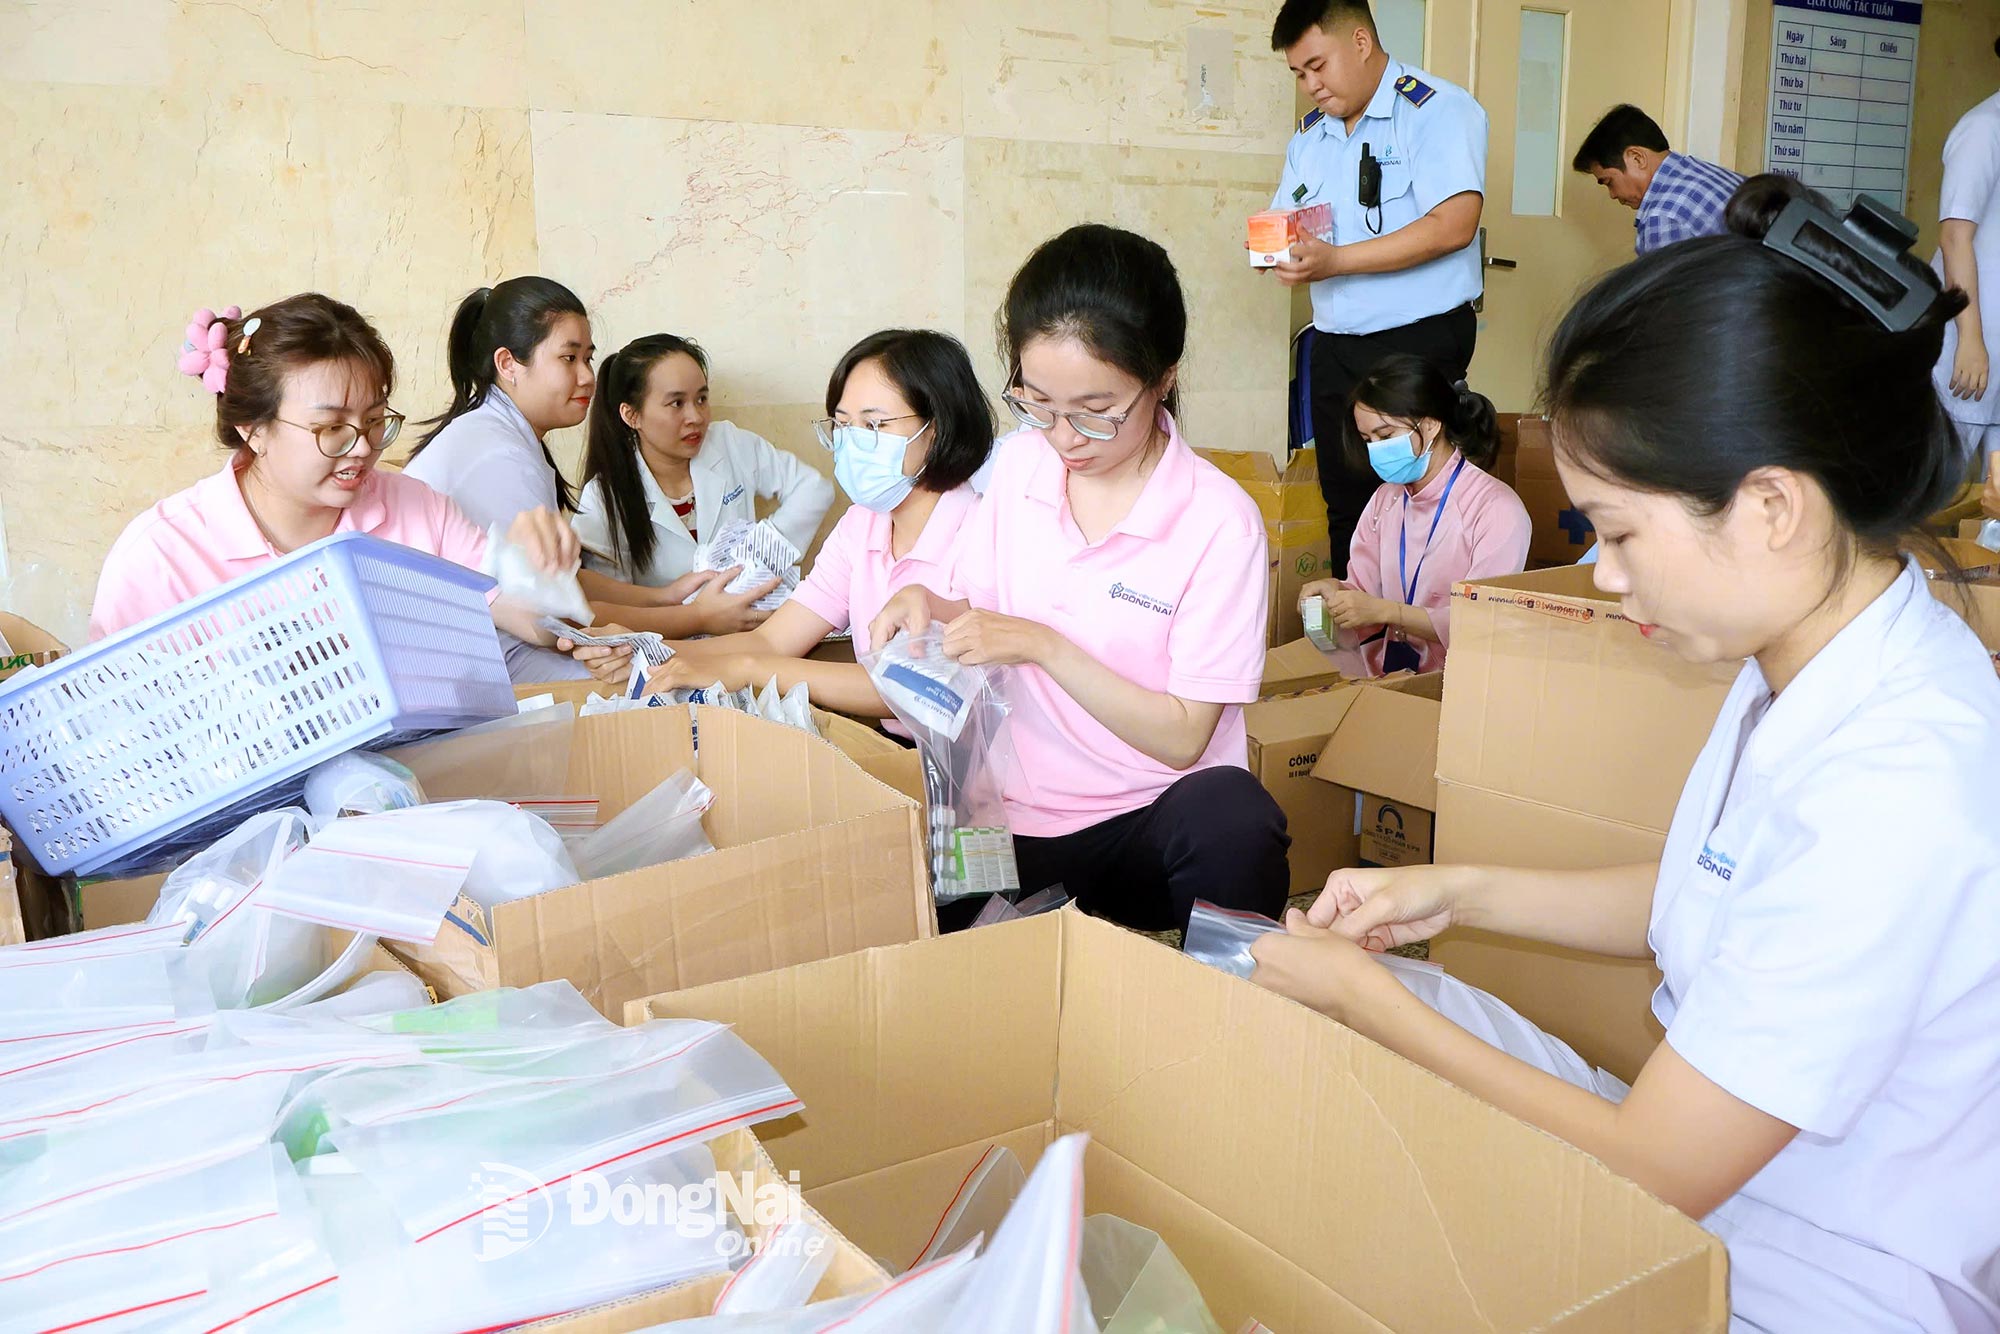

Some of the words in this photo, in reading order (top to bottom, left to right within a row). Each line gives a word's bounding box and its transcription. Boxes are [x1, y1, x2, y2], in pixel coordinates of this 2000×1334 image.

[1795, 53, 1807, 65] hai
[1795, 77, 1804, 88] ba
[1152, 604, 1173, 616] NAI
